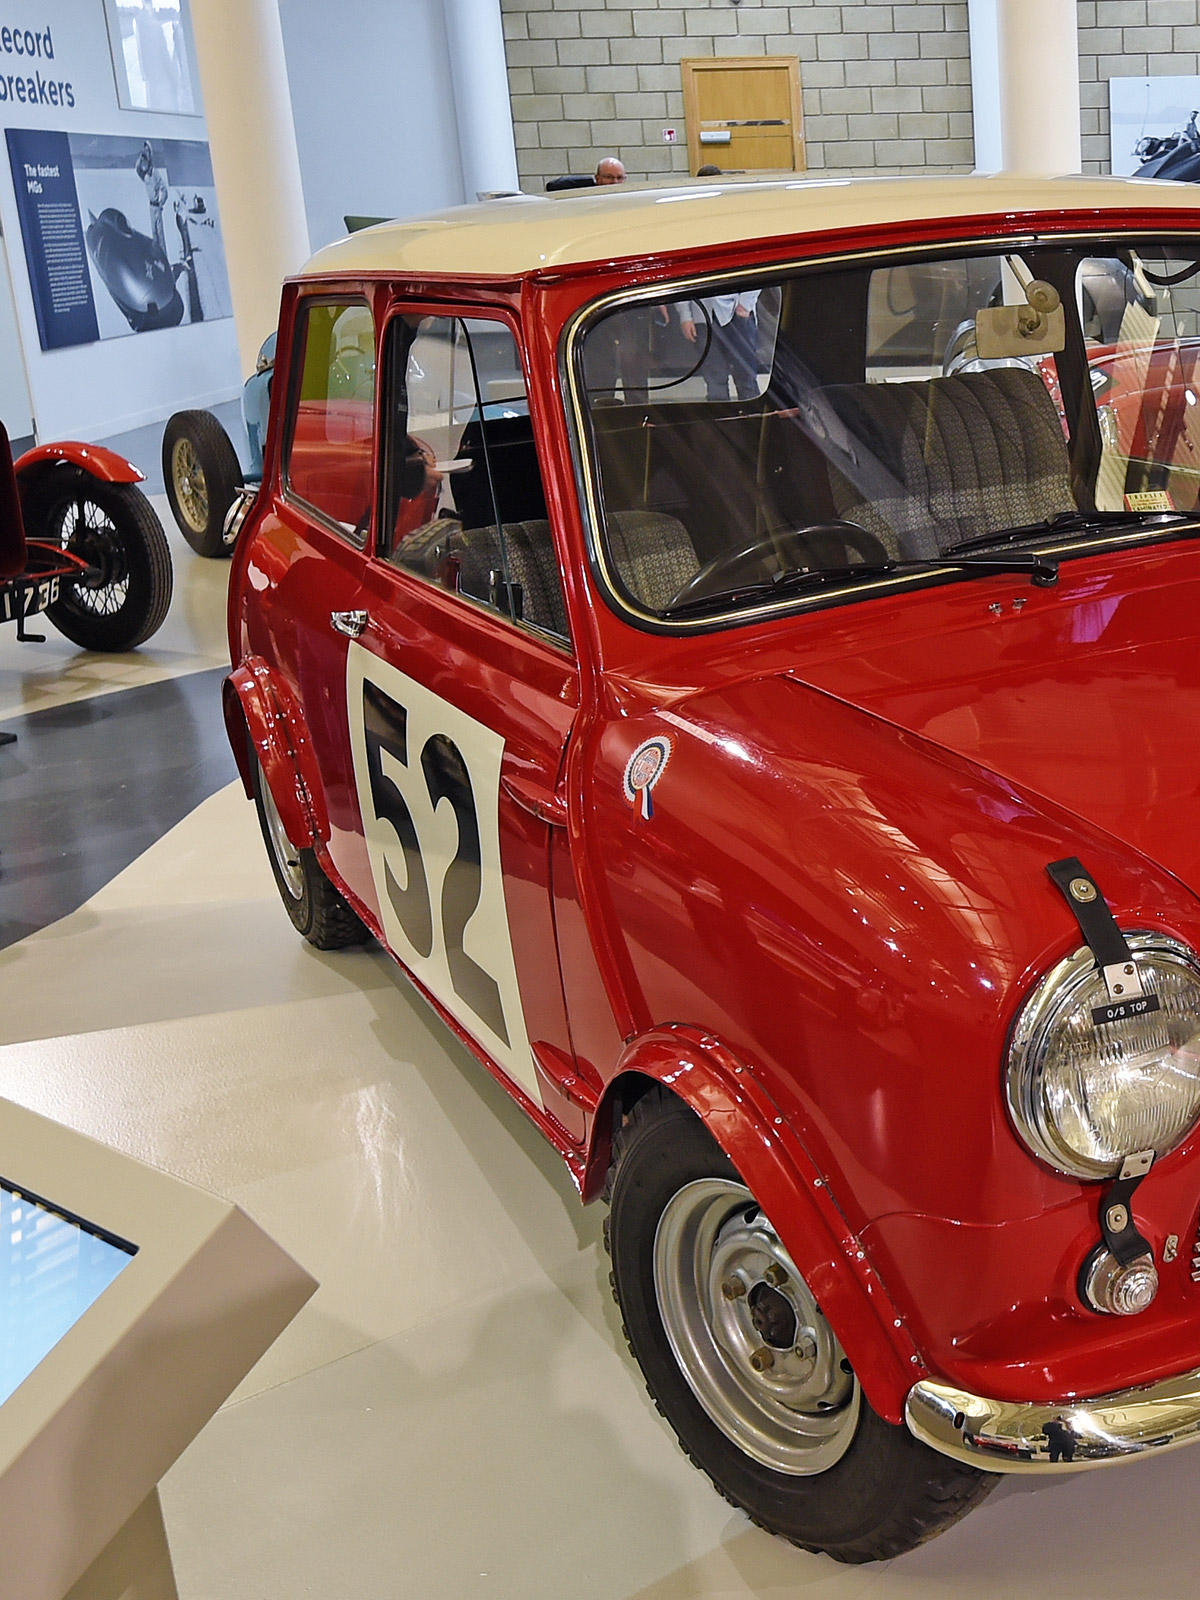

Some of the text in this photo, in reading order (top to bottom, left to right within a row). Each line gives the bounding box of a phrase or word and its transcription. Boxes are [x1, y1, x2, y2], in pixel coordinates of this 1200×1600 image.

[0, 25, 54, 60] ecord
[24, 164, 60, 177] The fastest
[363, 677, 512, 1050] 52
[1107, 1001, 1147, 1018] O/S TOP
